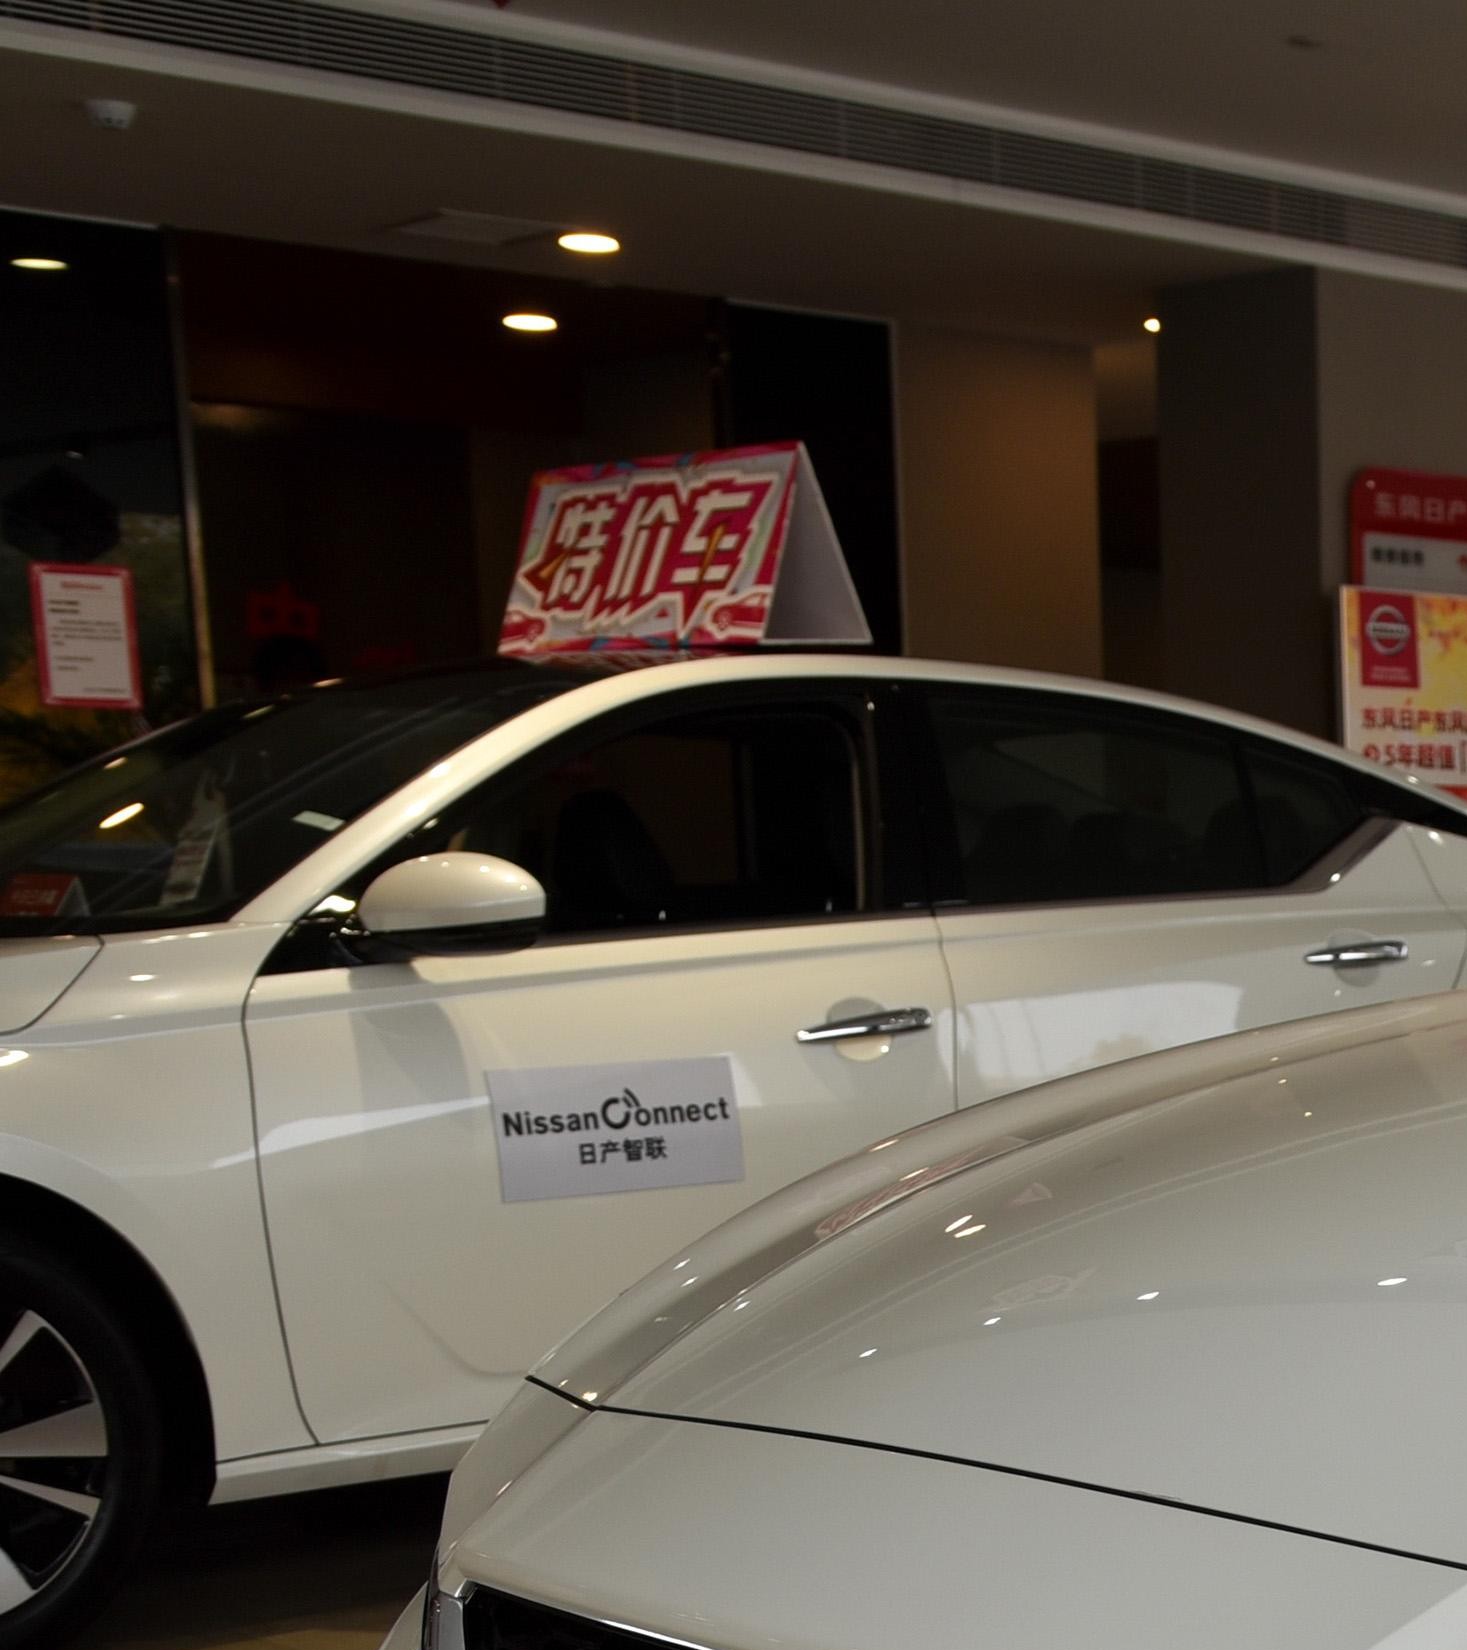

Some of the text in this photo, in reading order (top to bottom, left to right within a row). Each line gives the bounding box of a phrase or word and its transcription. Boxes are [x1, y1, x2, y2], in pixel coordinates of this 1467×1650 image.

[542, 486, 756, 606] 特价车
[502, 1088, 730, 1137] NissanConnect
[578, 1136, 668, 1165] 日产智联
